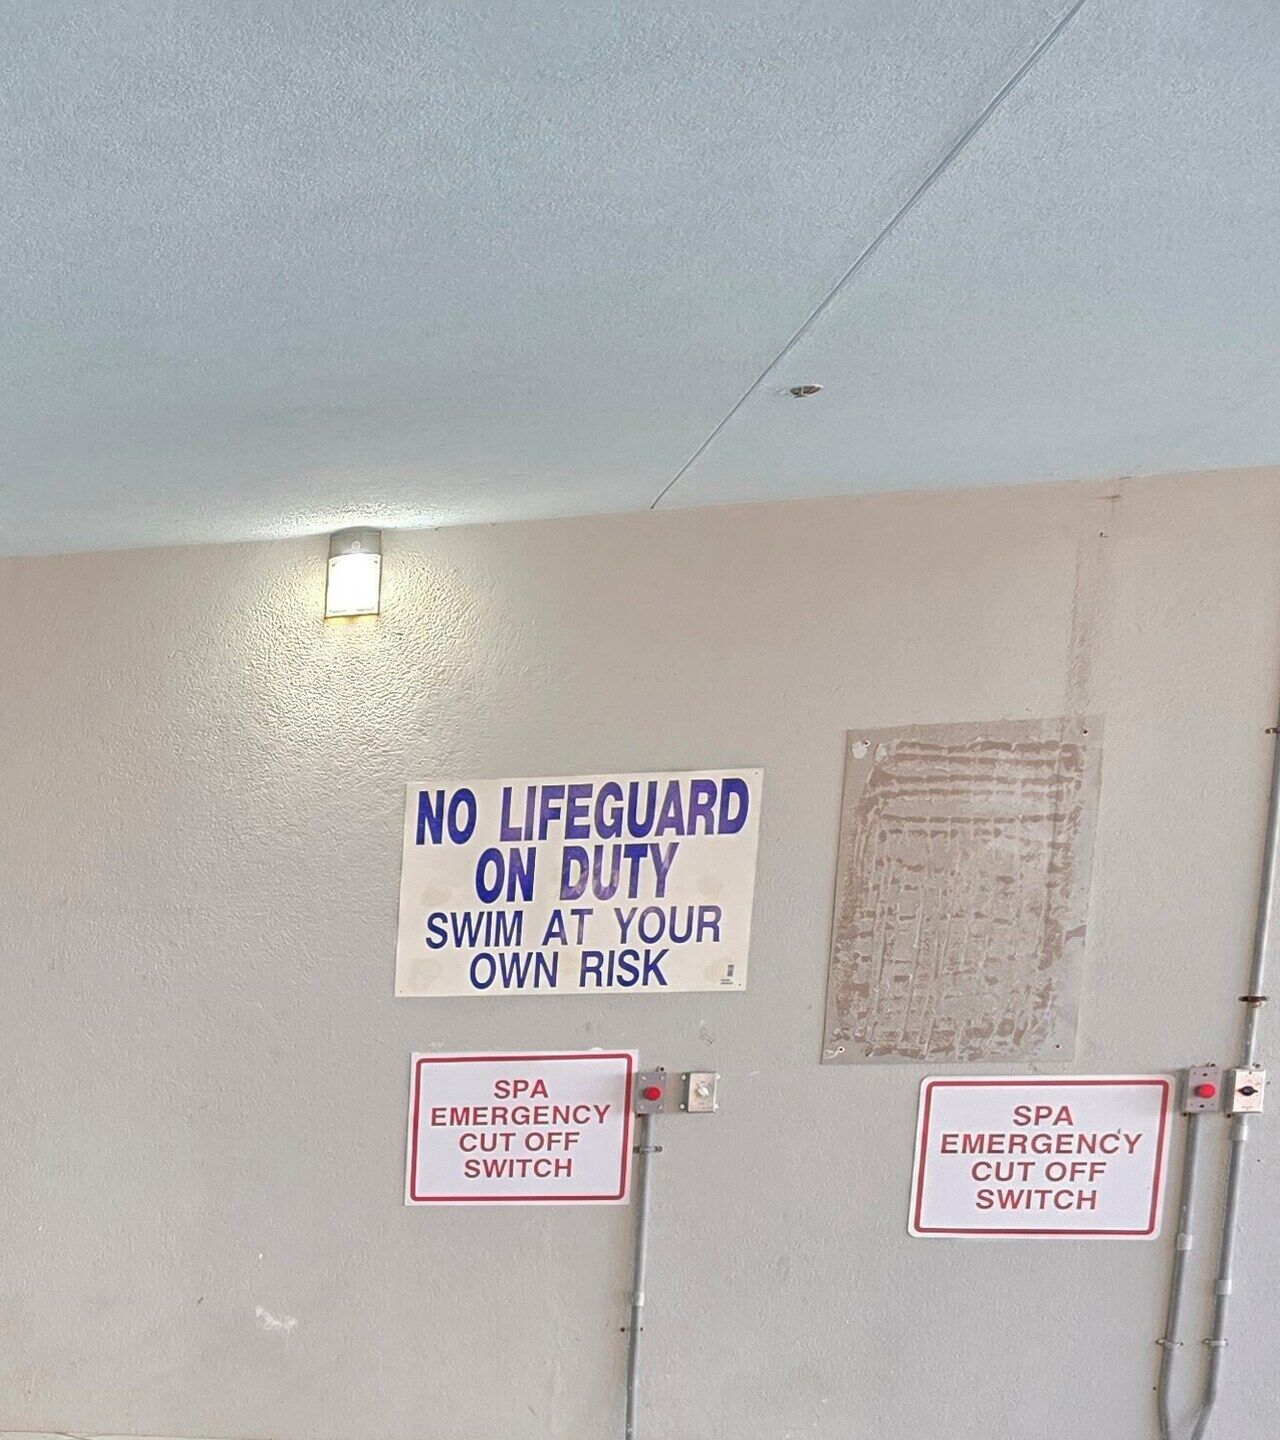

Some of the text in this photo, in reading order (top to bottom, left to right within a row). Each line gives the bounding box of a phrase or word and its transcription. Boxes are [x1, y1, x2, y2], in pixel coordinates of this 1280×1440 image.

[416, 777, 750, 846] NO LIFEGUARD
[475, 842, 680, 904] ON DUTY
[425, 905, 723, 949] SWIM AT YOUR
[469, 948, 671, 990] OWN RISK
[493, 1078, 549, 1099] SPA
[430, 1103, 612, 1127] EMERGENCY
[1012, 1104, 1074, 1127] SPA
[458, 1131, 580, 1153] CUT OFF
[939, 1132, 1144, 1155] EMERGENCY
[463, 1158, 573, 1179] SWITCH
[970, 1161, 1107, 1183] CUT OFF
[975, 1189, 1098, 1211] SWITCH
